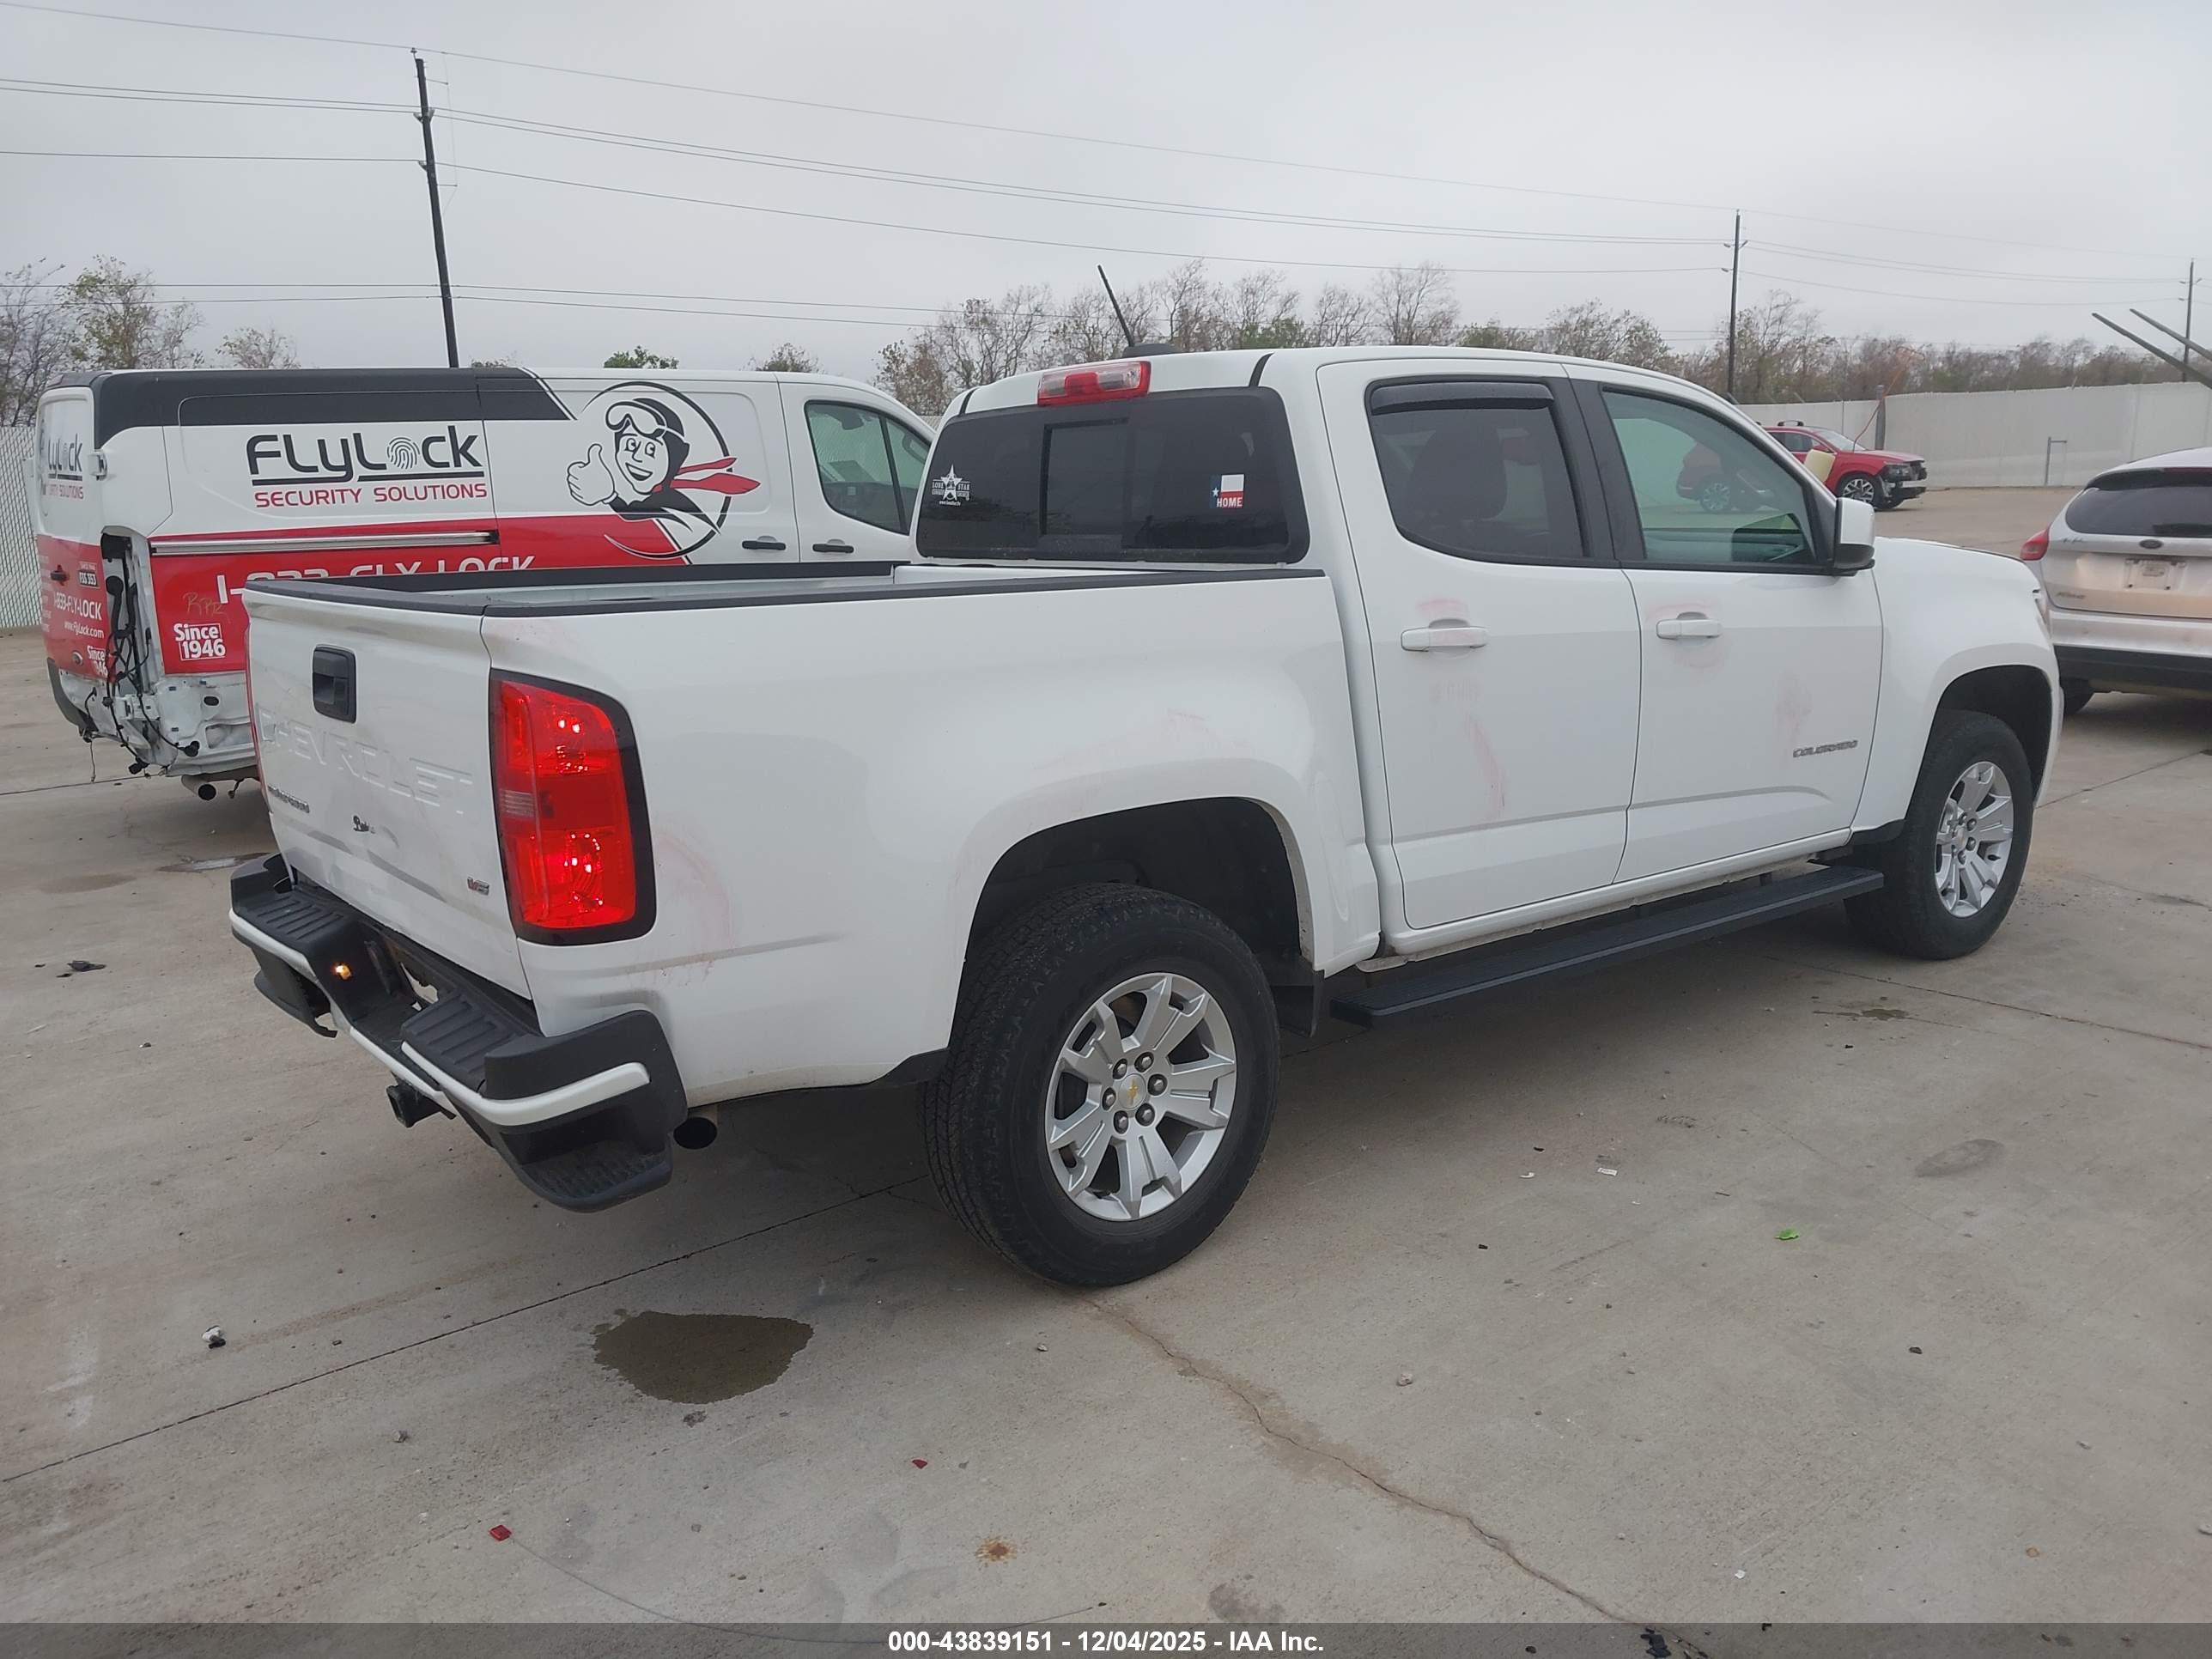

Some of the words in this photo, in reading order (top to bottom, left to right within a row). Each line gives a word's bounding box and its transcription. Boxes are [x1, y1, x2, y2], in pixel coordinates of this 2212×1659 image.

[254, 487, 362, 507] SECURITY
[374, 483, 488, 502] SOLUTIONS
[1216, 497, 1243, 507] HOME
[173, 623, 220, 641] Since
[87, 645, 106, 660] Since
[182, 639, 226, 659] 1946
